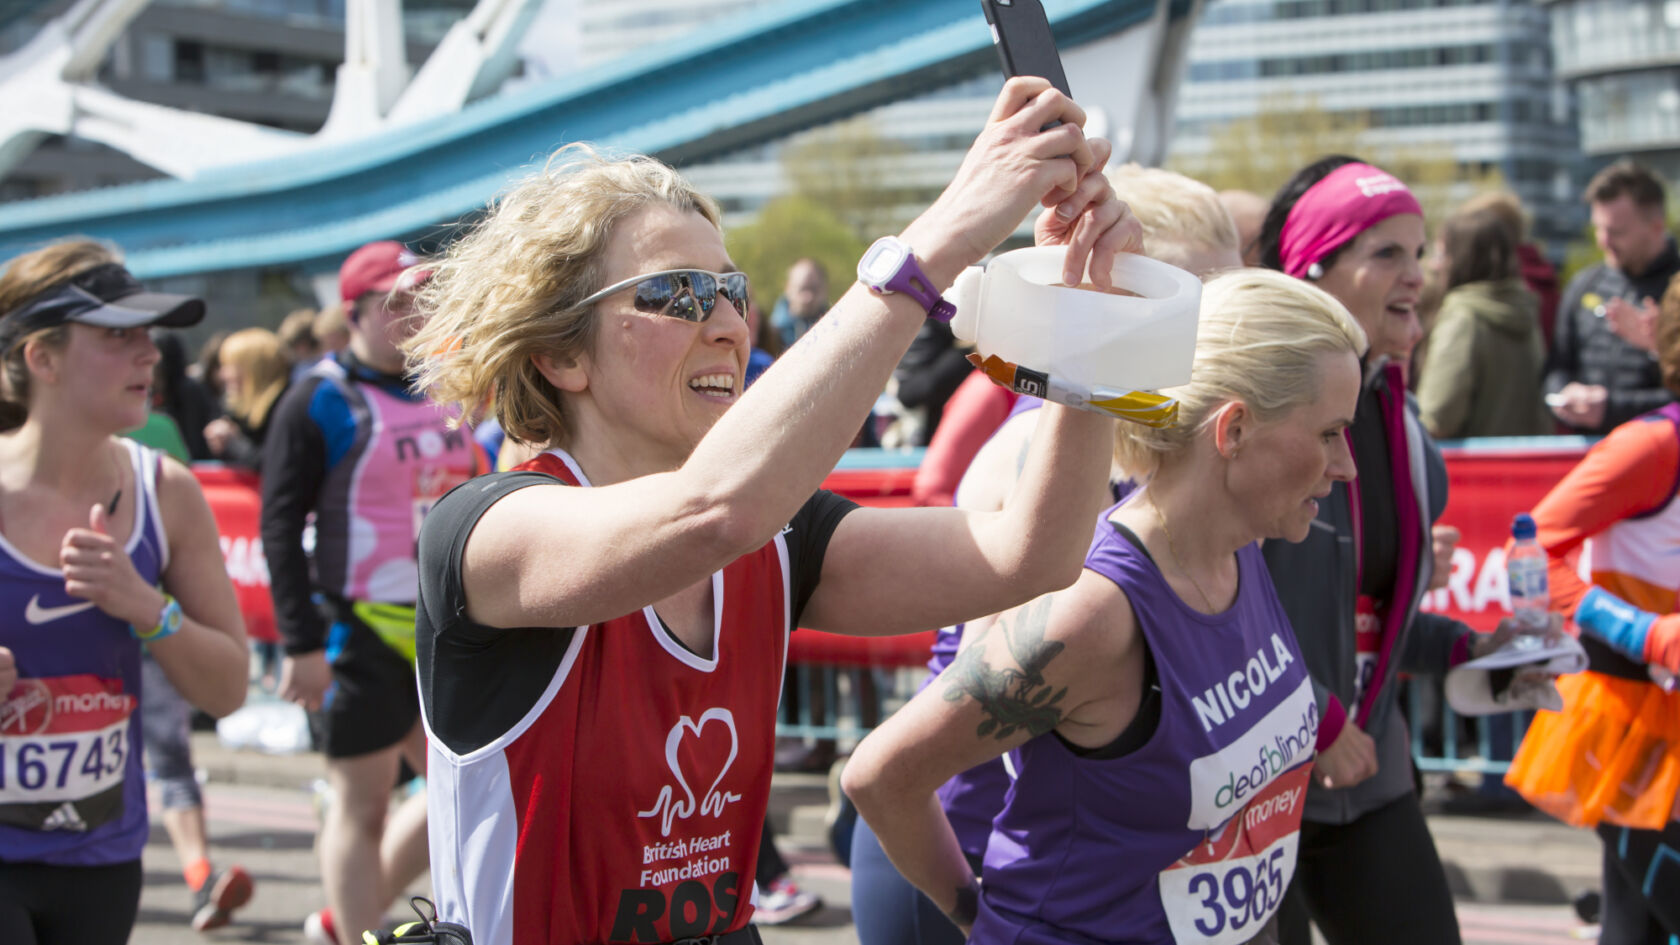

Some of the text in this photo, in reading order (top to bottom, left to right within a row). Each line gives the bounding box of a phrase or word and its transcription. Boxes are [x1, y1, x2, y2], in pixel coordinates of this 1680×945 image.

[1192, 632, 1295, 733] NICOLA
[0, 729, 123, 791] 16743
[1245, 785, 1302, 831] money
[640, 855, 730, 888] Foundation
[642, 830, 731, 865] British Heart
[1188, 846, 1285, 938] 3965
